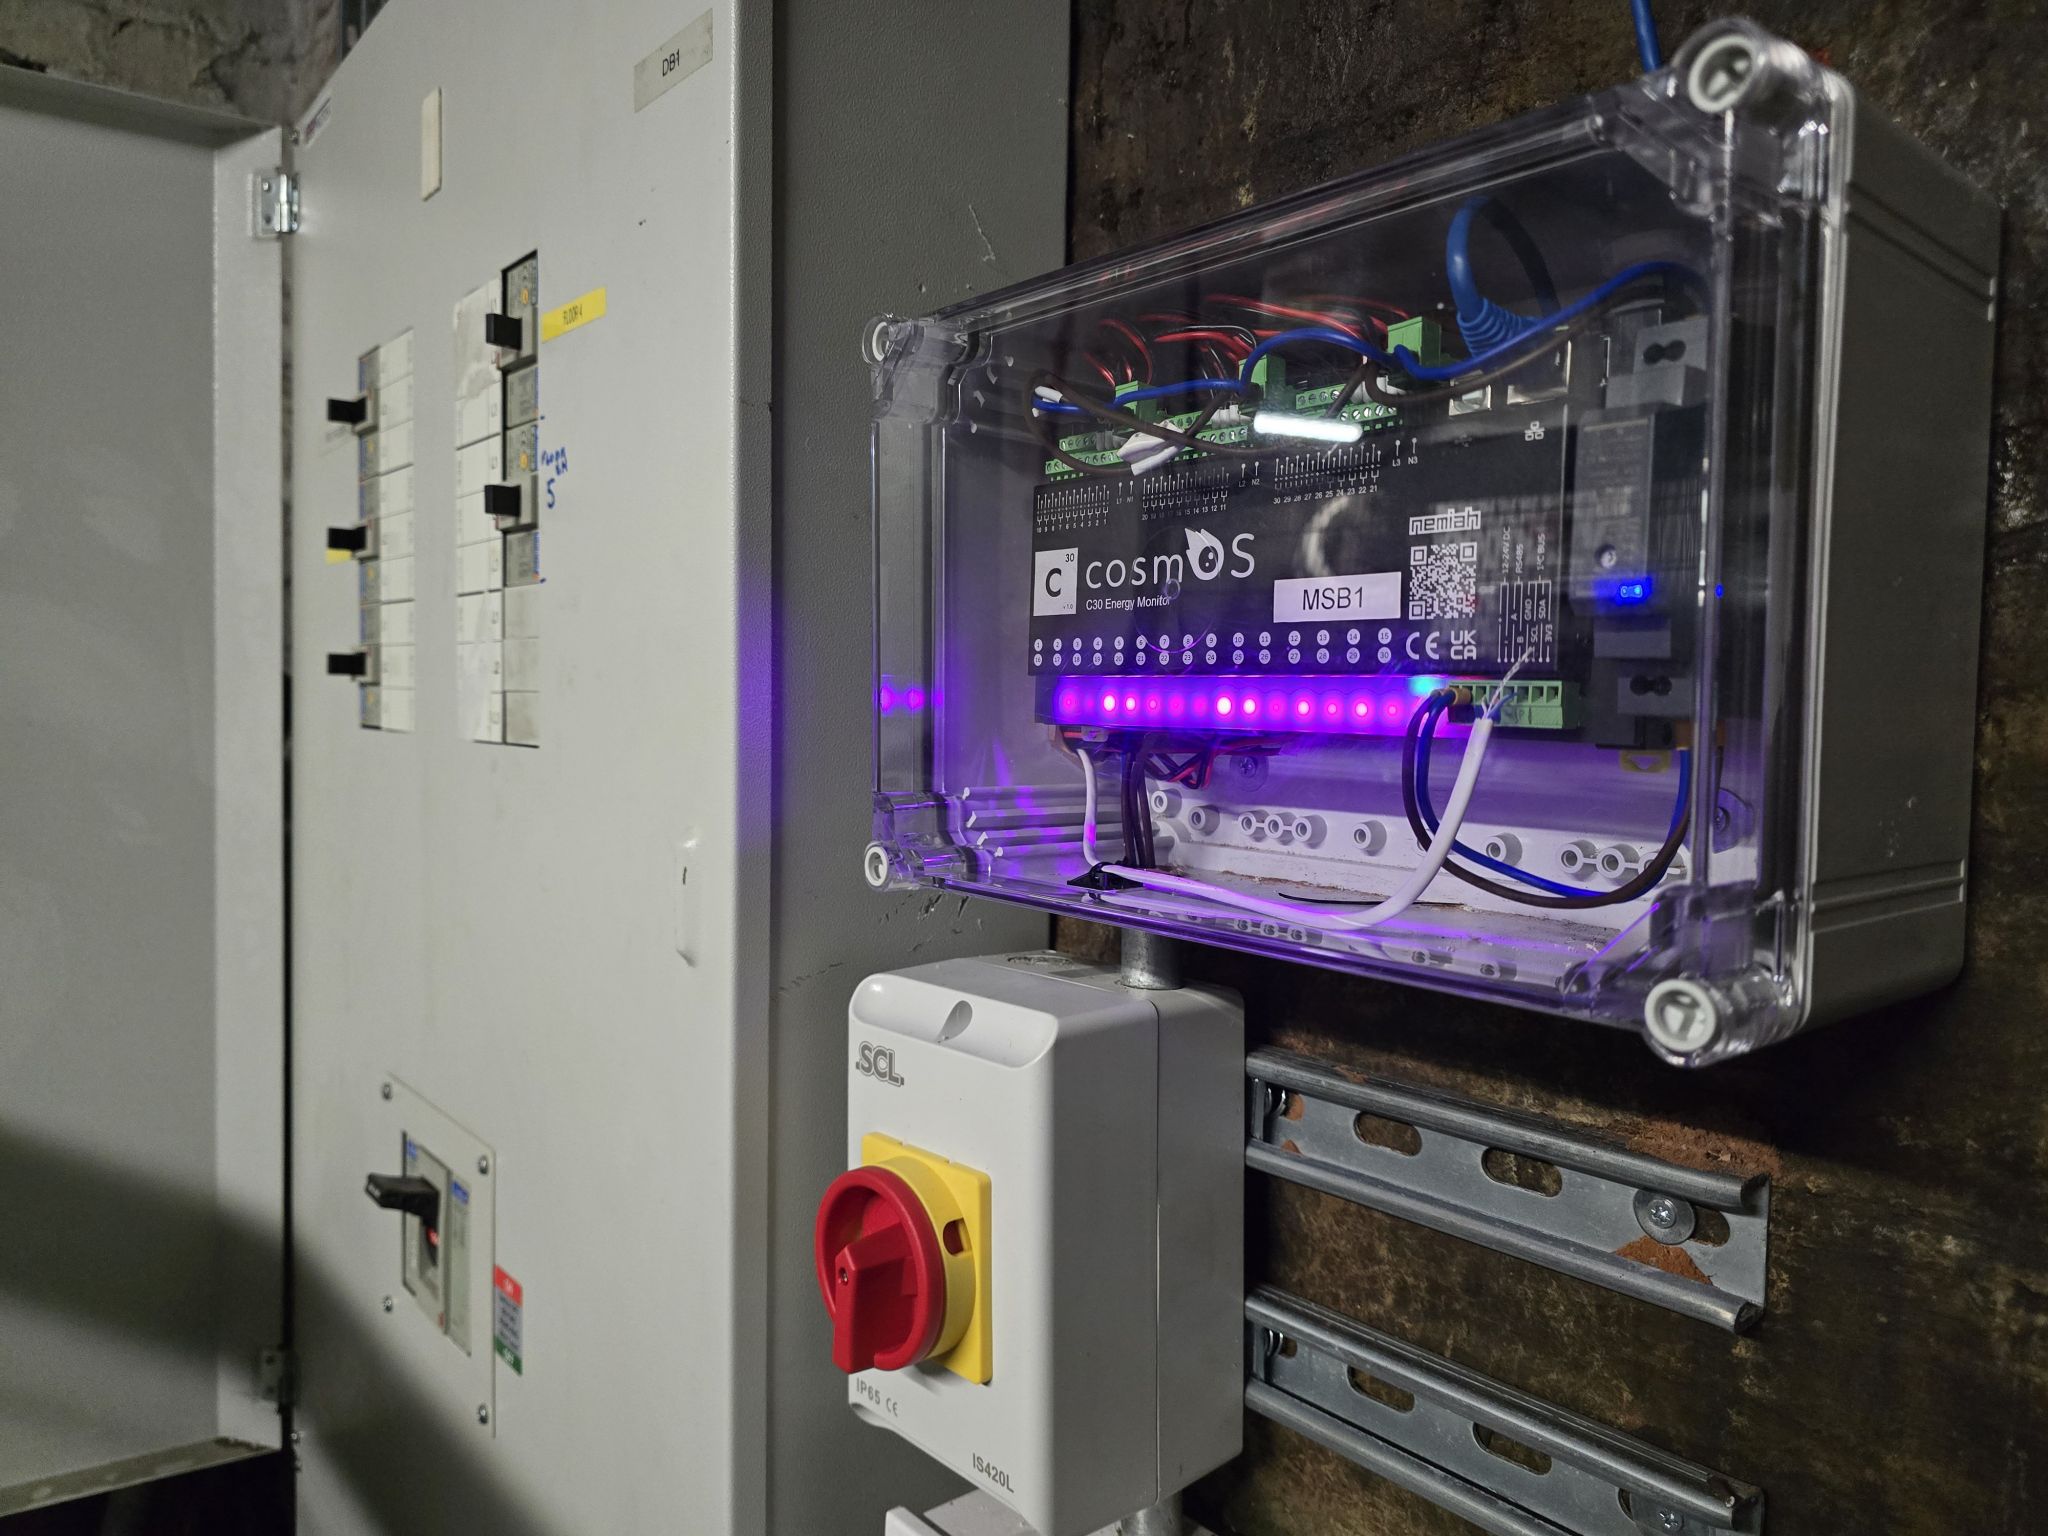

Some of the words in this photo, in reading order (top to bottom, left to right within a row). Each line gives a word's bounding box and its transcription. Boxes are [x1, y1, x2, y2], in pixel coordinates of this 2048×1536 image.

[662, 48, 680, 77] DB1
[1392, 459, 1401, 467] L3
[1407, 456, 1418, 465] N3
[1284, 496, 1292, 504] 29
[1304, 494, 1312, 502] 27
[1315, 492, 1323, 500] 26
[1326, 491, 1334, 499] 25
[1336, 490, 1344, 498] 24
[1347, 489, 1355, 497] 23
[1358, 488, 1366, 496] 22
[1370, 486, 1378, 494] 21
[1502, 526, 1510, 540] DC
[1538, 533, 1546, 554] BUS
[1065, 553, 1075, 563] 30
[1516, 544, 1524, 574] RS485
[1045, 567, 1062, 597] C
[1086, 599, 1103, 611] C30
[1105, 597, 1134, 611] Energy
[1137, 594, 1171, 608] Monitor
[1302, 586, 1363, 611] MSB1
[1510, 613, 1518, 621] A
[1450, 630, 1477, 645] UK
[1530, 624, 1538, 644] SCL
[1544, 624, 1552, 642] 3V3
[1450, 646, 1477, 660] CA
[856, 1040, 905, 1088] SCL
[856, 1377, 881, 1405] IP65
[972, 1453, 1014, 1493] IS420L
